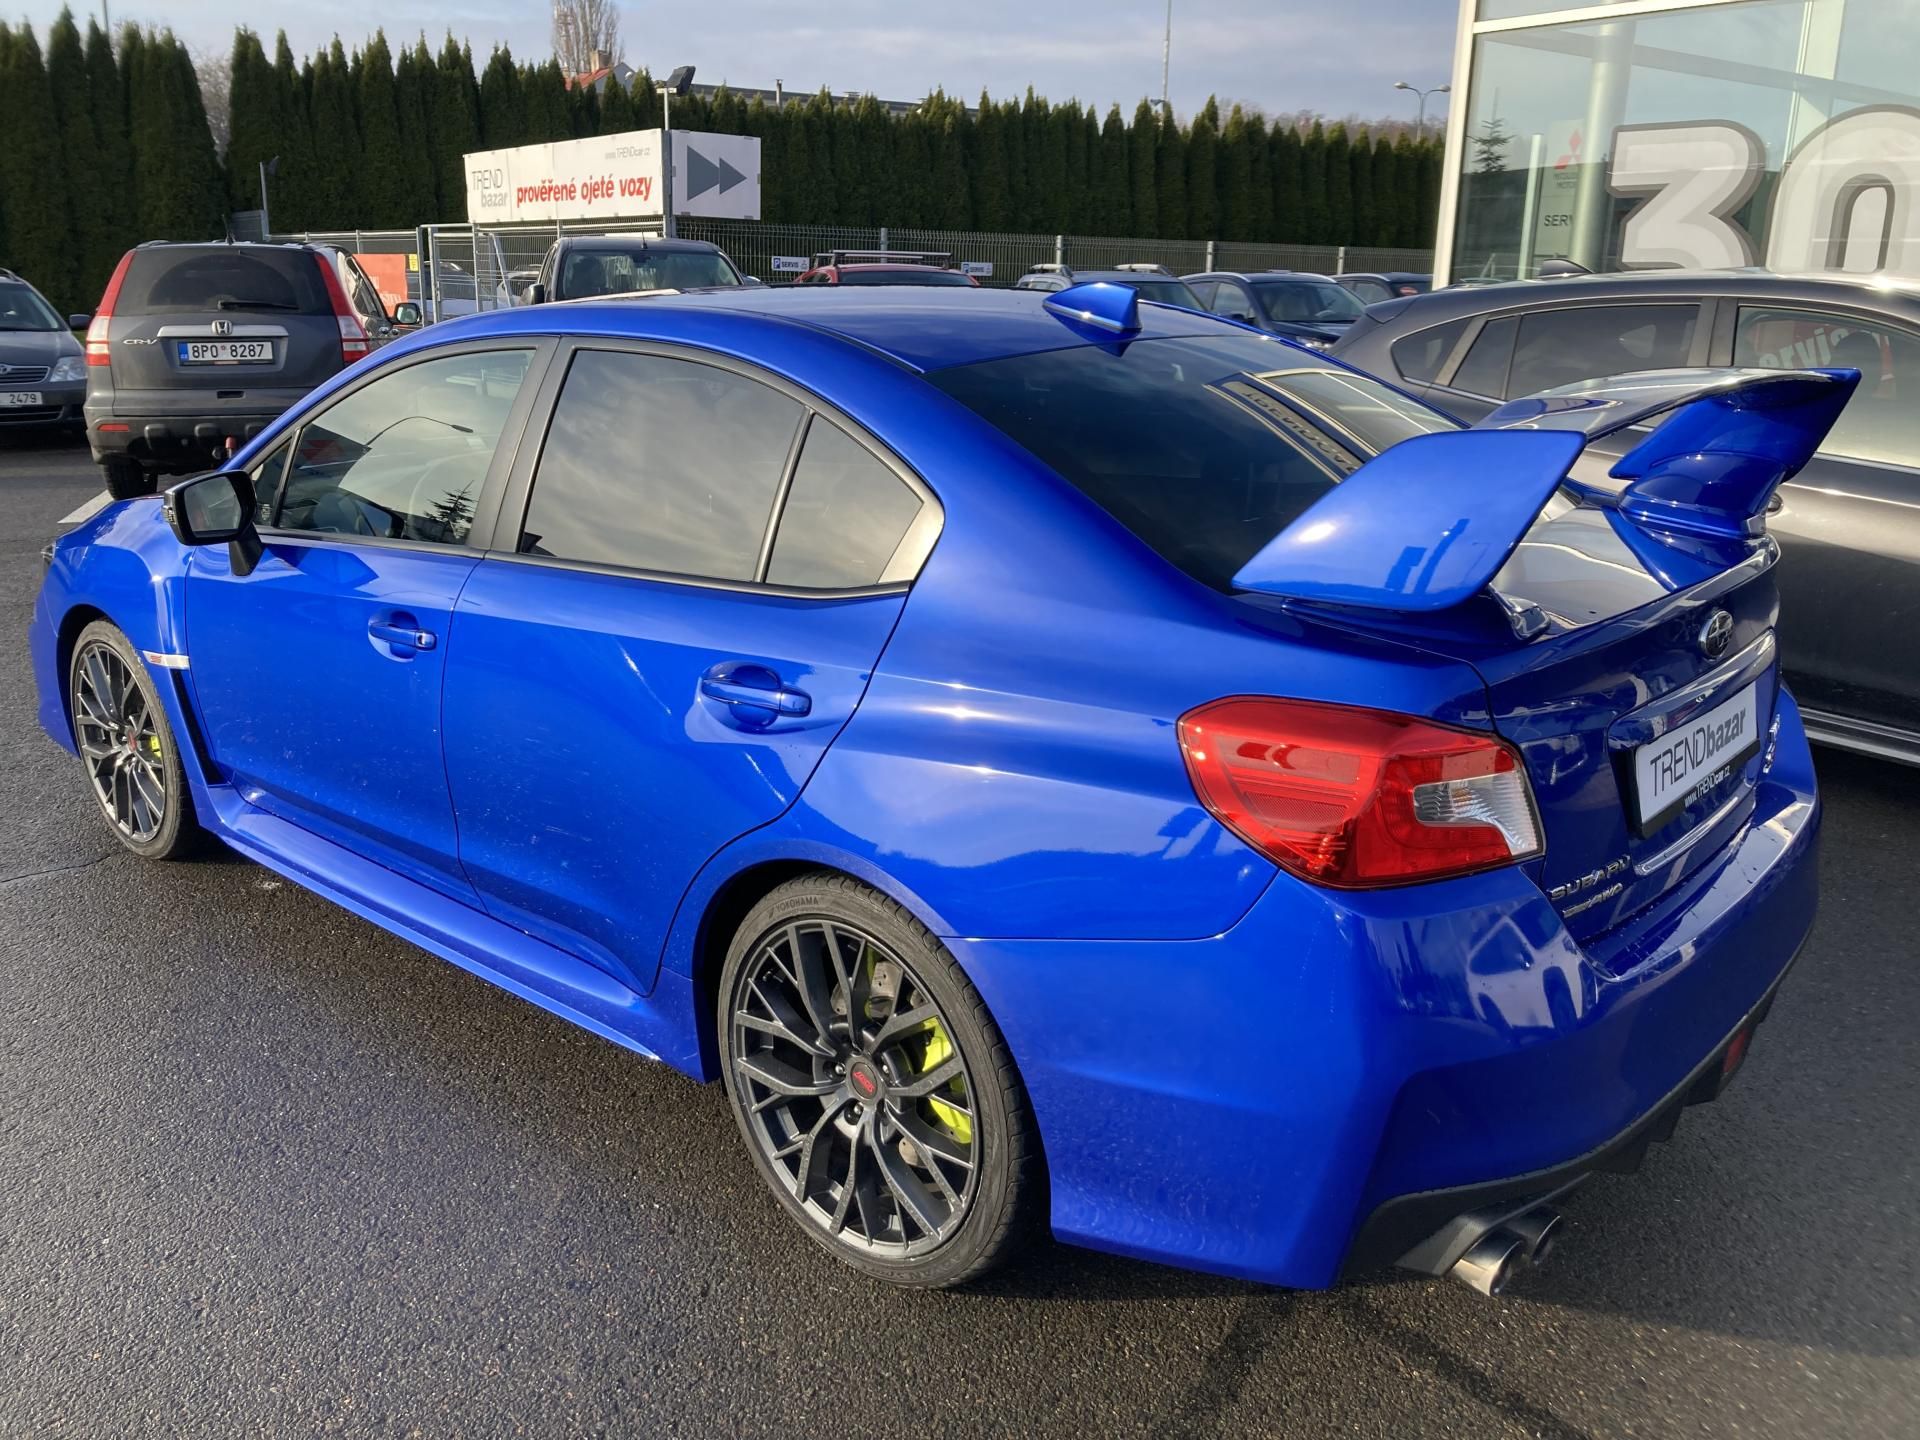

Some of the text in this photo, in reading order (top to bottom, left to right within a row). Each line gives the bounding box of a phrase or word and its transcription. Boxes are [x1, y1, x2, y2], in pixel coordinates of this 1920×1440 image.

[472, 169, 503, 190] TREND
[481, 189, 508, 207] bazar
[517, 174, 652, 208] prověřené ojeté vozy
[230, 344, 265, 358] 8287
[9, 394, 37, 404] 2479
[1551, 854, 1631, 901] SUBARU
[775, 896, 819, 911] YOKOHAMA
